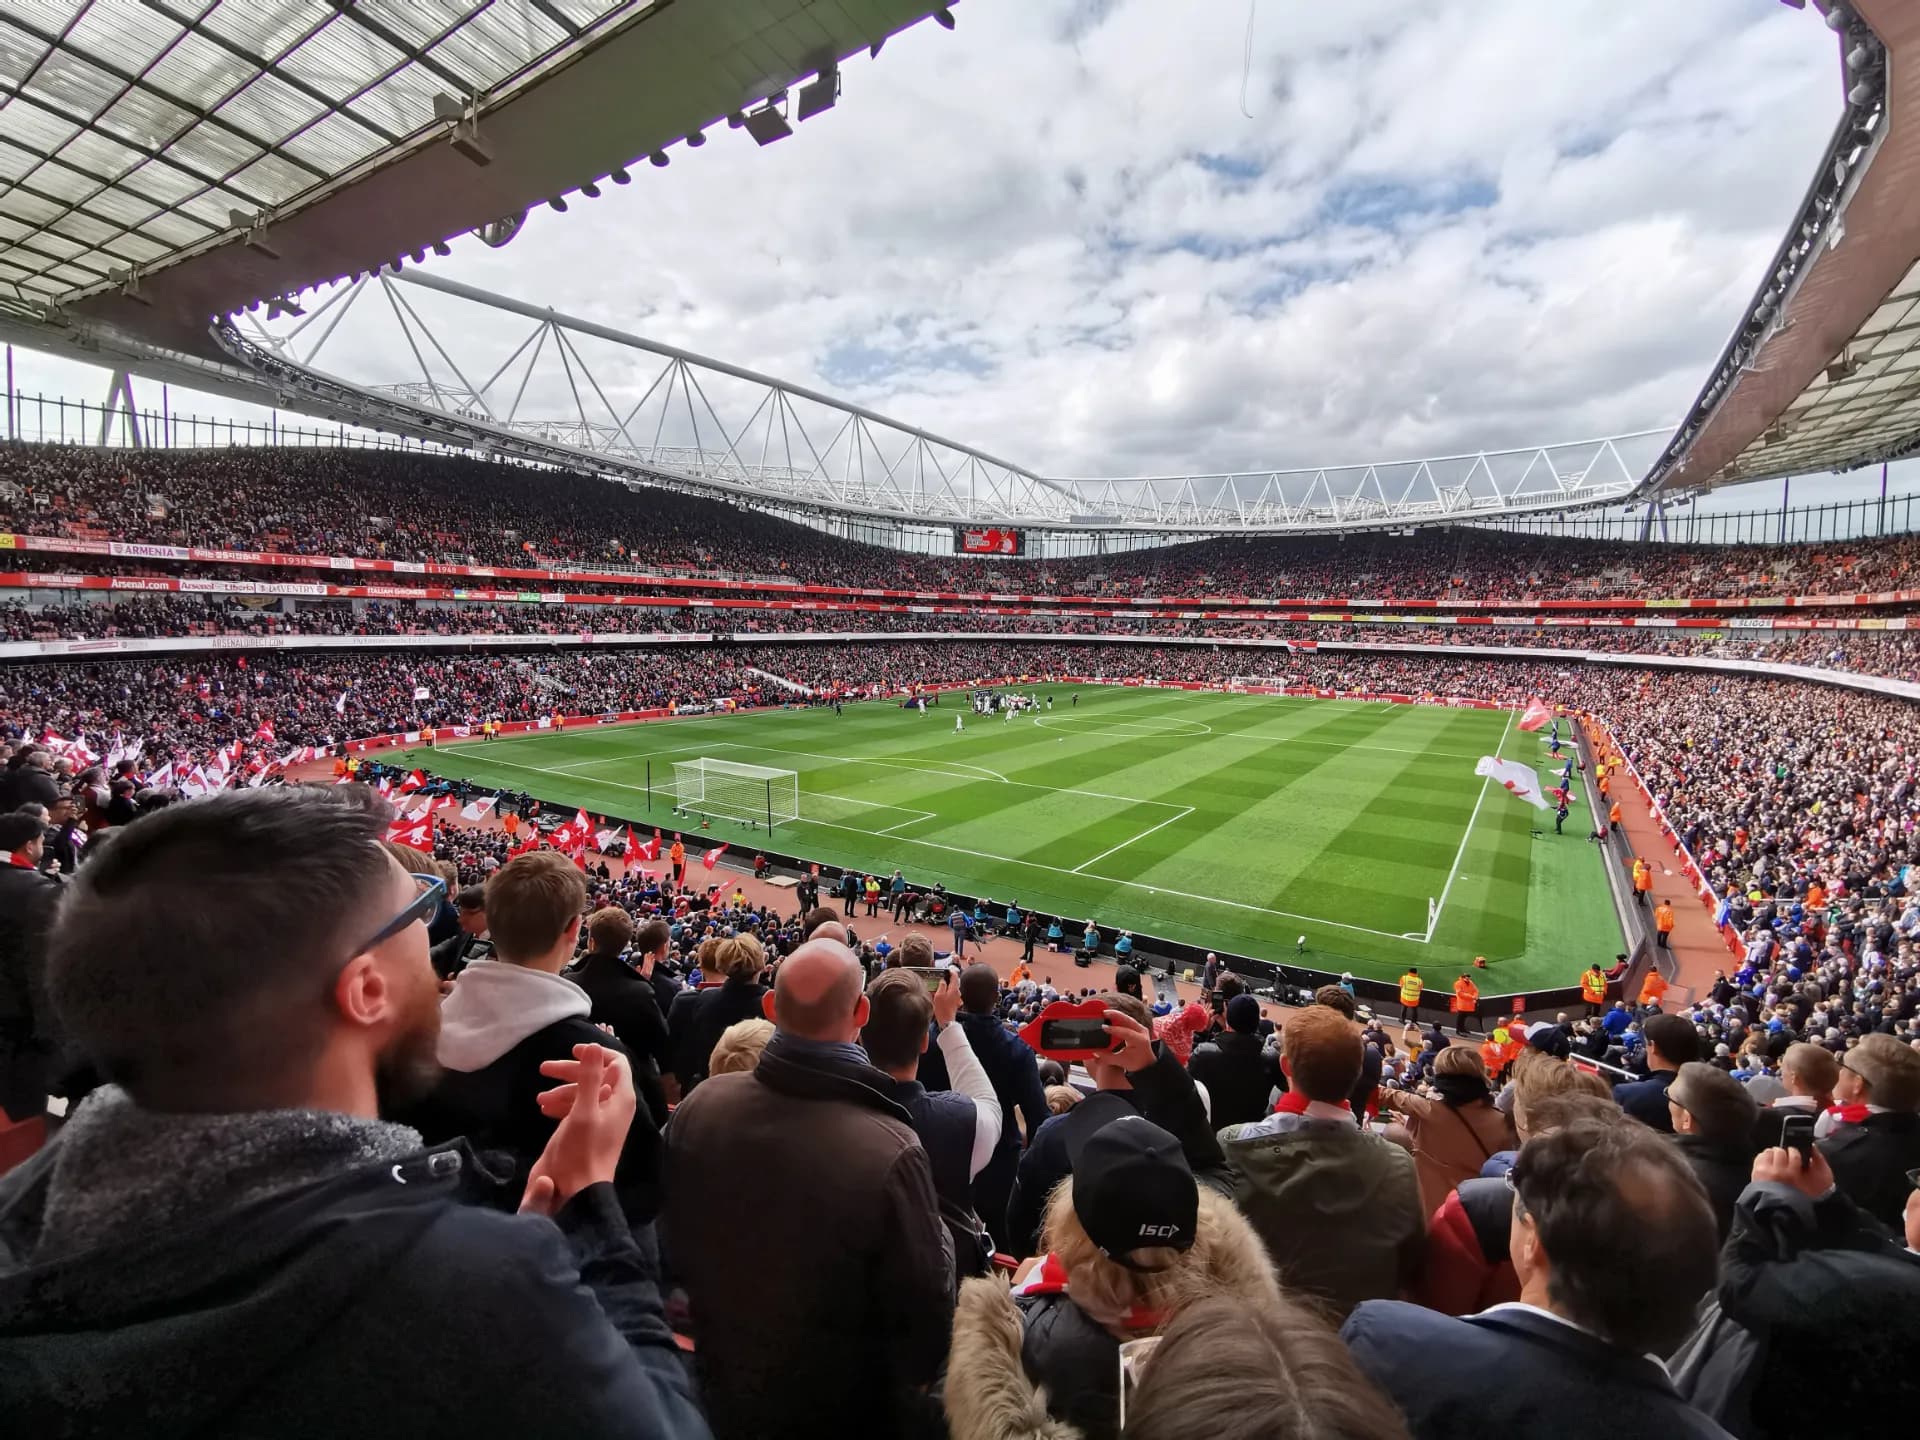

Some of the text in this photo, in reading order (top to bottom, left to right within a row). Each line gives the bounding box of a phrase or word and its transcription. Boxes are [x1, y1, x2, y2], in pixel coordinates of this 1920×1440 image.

[125, 545, 174, 557] ARMENIA
[282, 556, 307, 566] 1938
[111, 579, 169, 590] Arsenal.com
[181, 581, 214, 591] Arsenal
[269, 584, 315, 594] DAVENTRY
